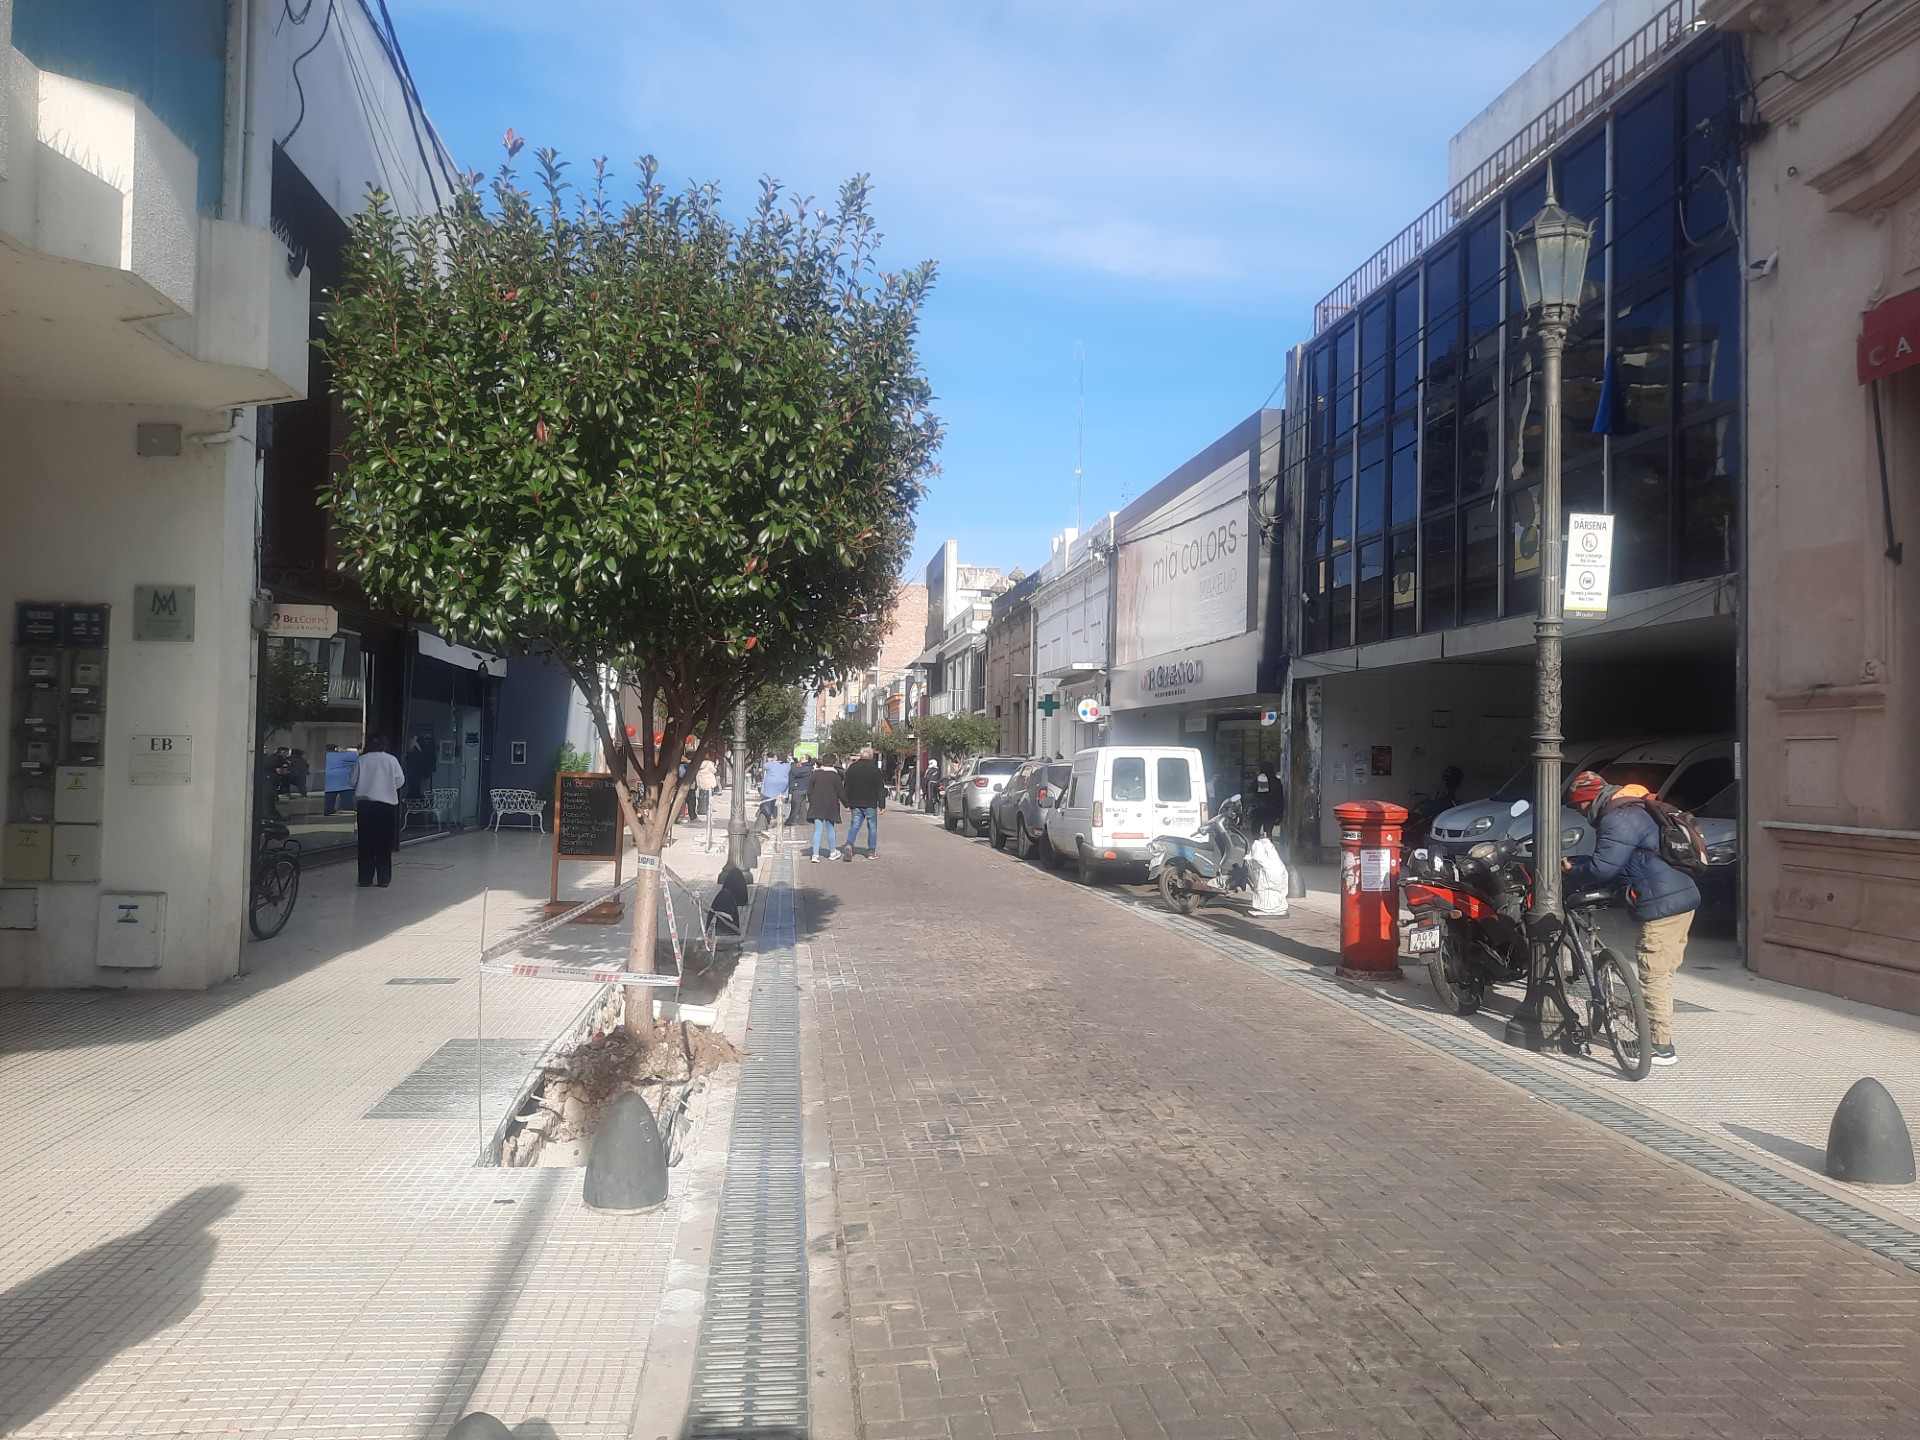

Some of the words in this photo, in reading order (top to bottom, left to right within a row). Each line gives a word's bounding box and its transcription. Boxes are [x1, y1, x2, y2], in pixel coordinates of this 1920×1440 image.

[1574, 518, 1607, 531] DÁRSENA
[1152, 545, 1178, 589] mia
[1181, 519, 1237, 575] COLORS
[150, 737, 173, 752] EB
